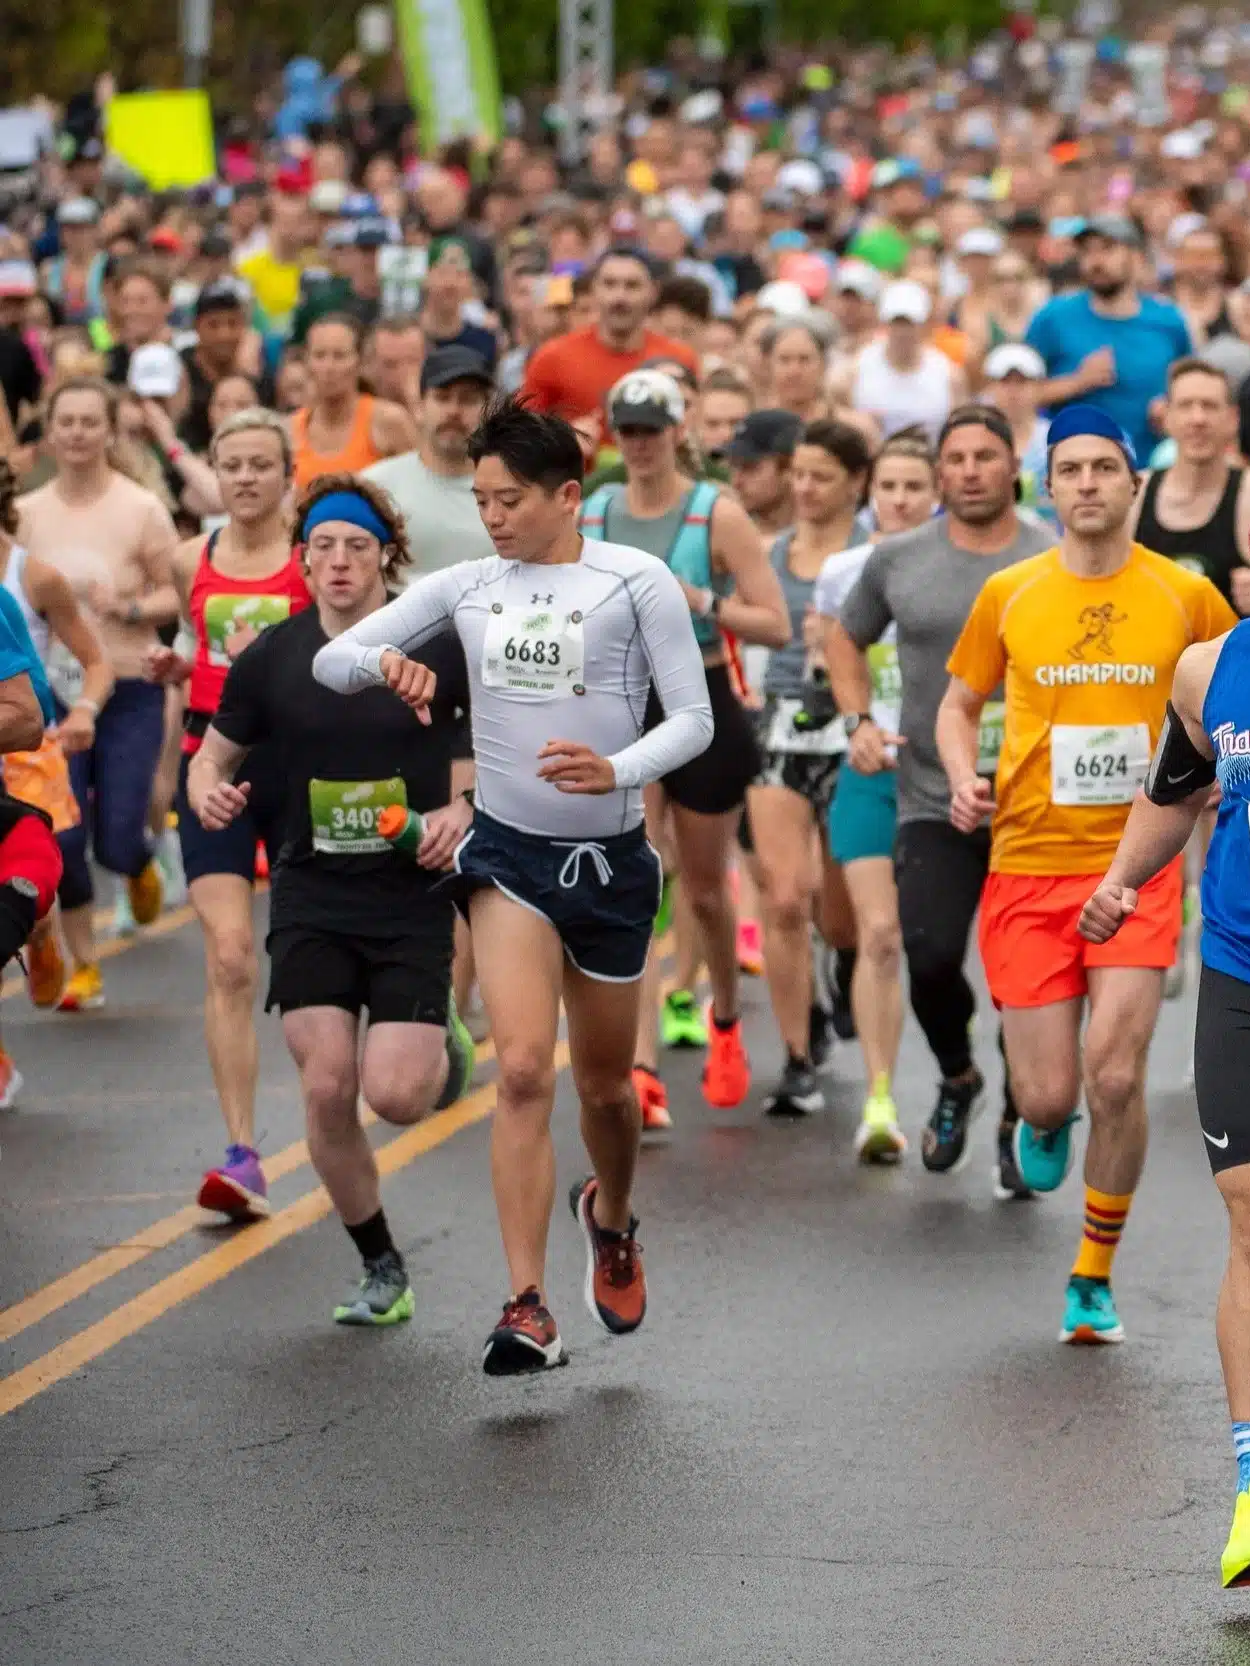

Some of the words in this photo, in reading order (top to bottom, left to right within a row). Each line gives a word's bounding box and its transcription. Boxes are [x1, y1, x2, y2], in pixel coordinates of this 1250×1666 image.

[505, 637, 560, 666] 6683
[1035, 663, 1156, 687] CHAMPION
[1074, 753, 1129, 778] 6624
